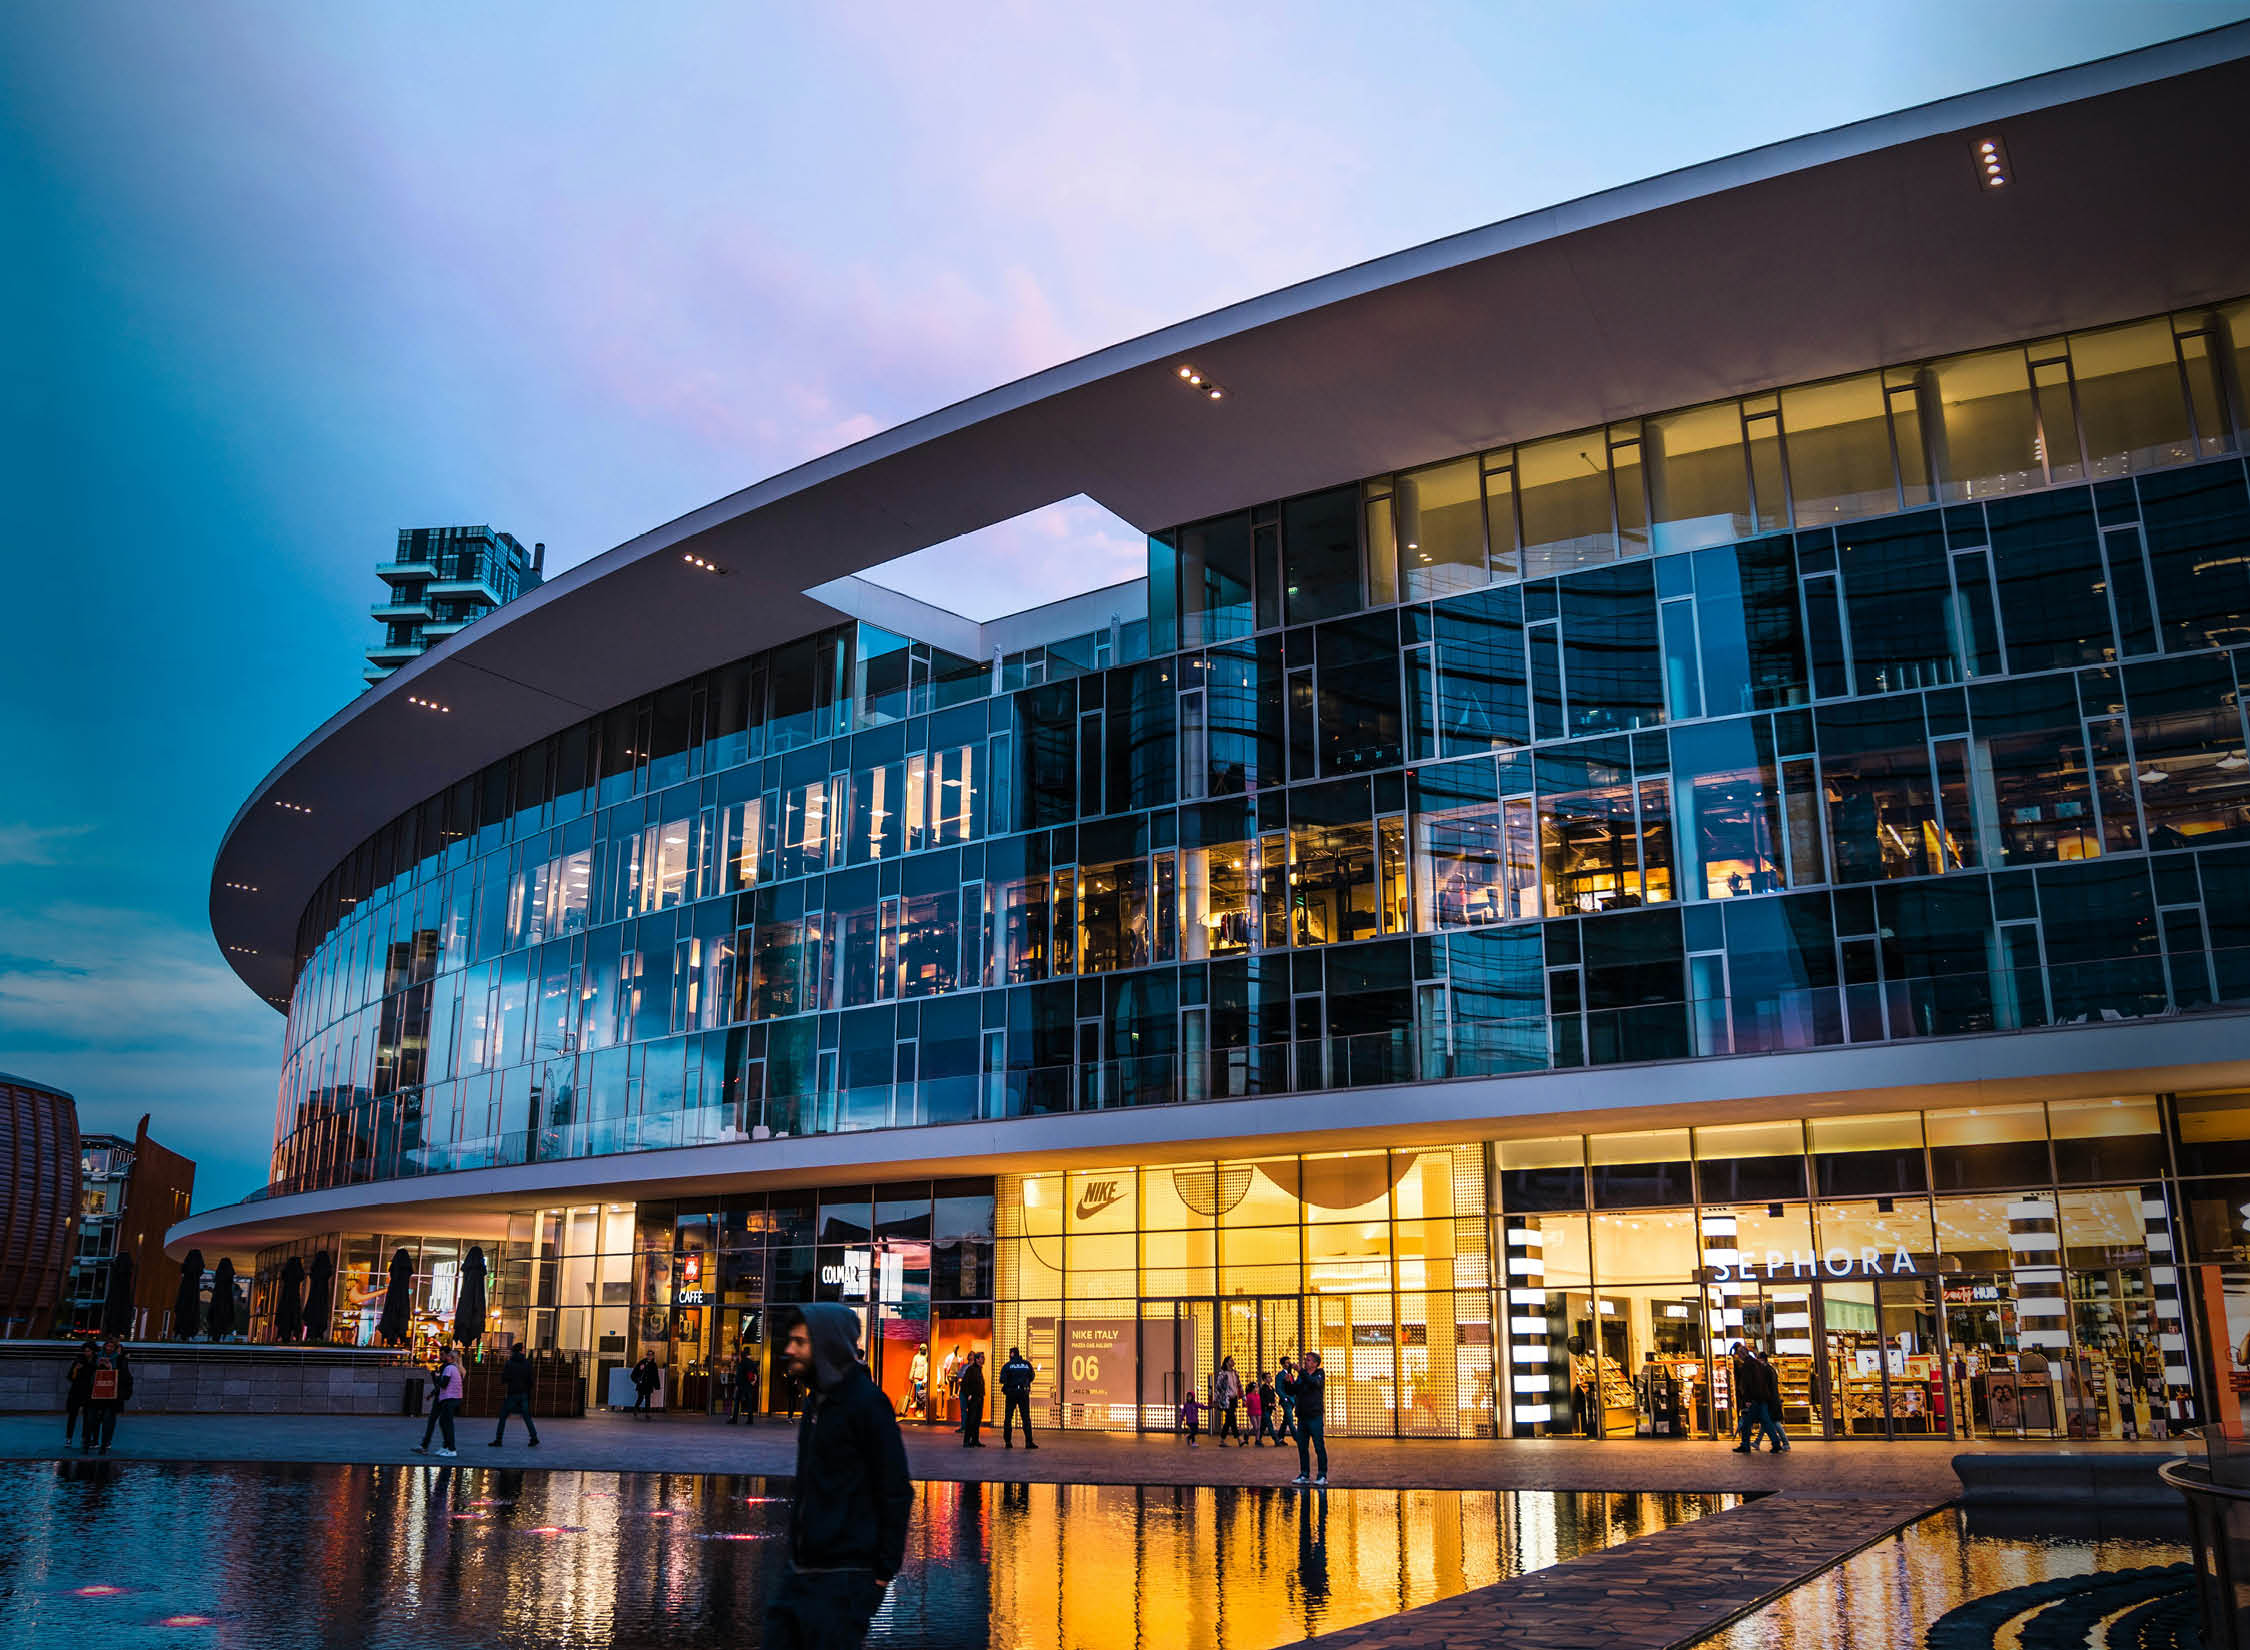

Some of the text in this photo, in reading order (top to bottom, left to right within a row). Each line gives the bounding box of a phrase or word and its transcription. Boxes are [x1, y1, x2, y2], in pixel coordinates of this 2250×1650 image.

[1083, 1181, 1118, 1202] NIKE
[1714, 1245, 1917, 1282] SEPHORA
[822, 1264, 859, 1284] COLMAR
[679, 1289, 704, 1304] CAFFÈ
[1973, 1286, 1999, 1300] HUB
[1072, 1330, 1119, 1340] NIKE ITALY
[1071, 1355, 1099, 1381] 06
